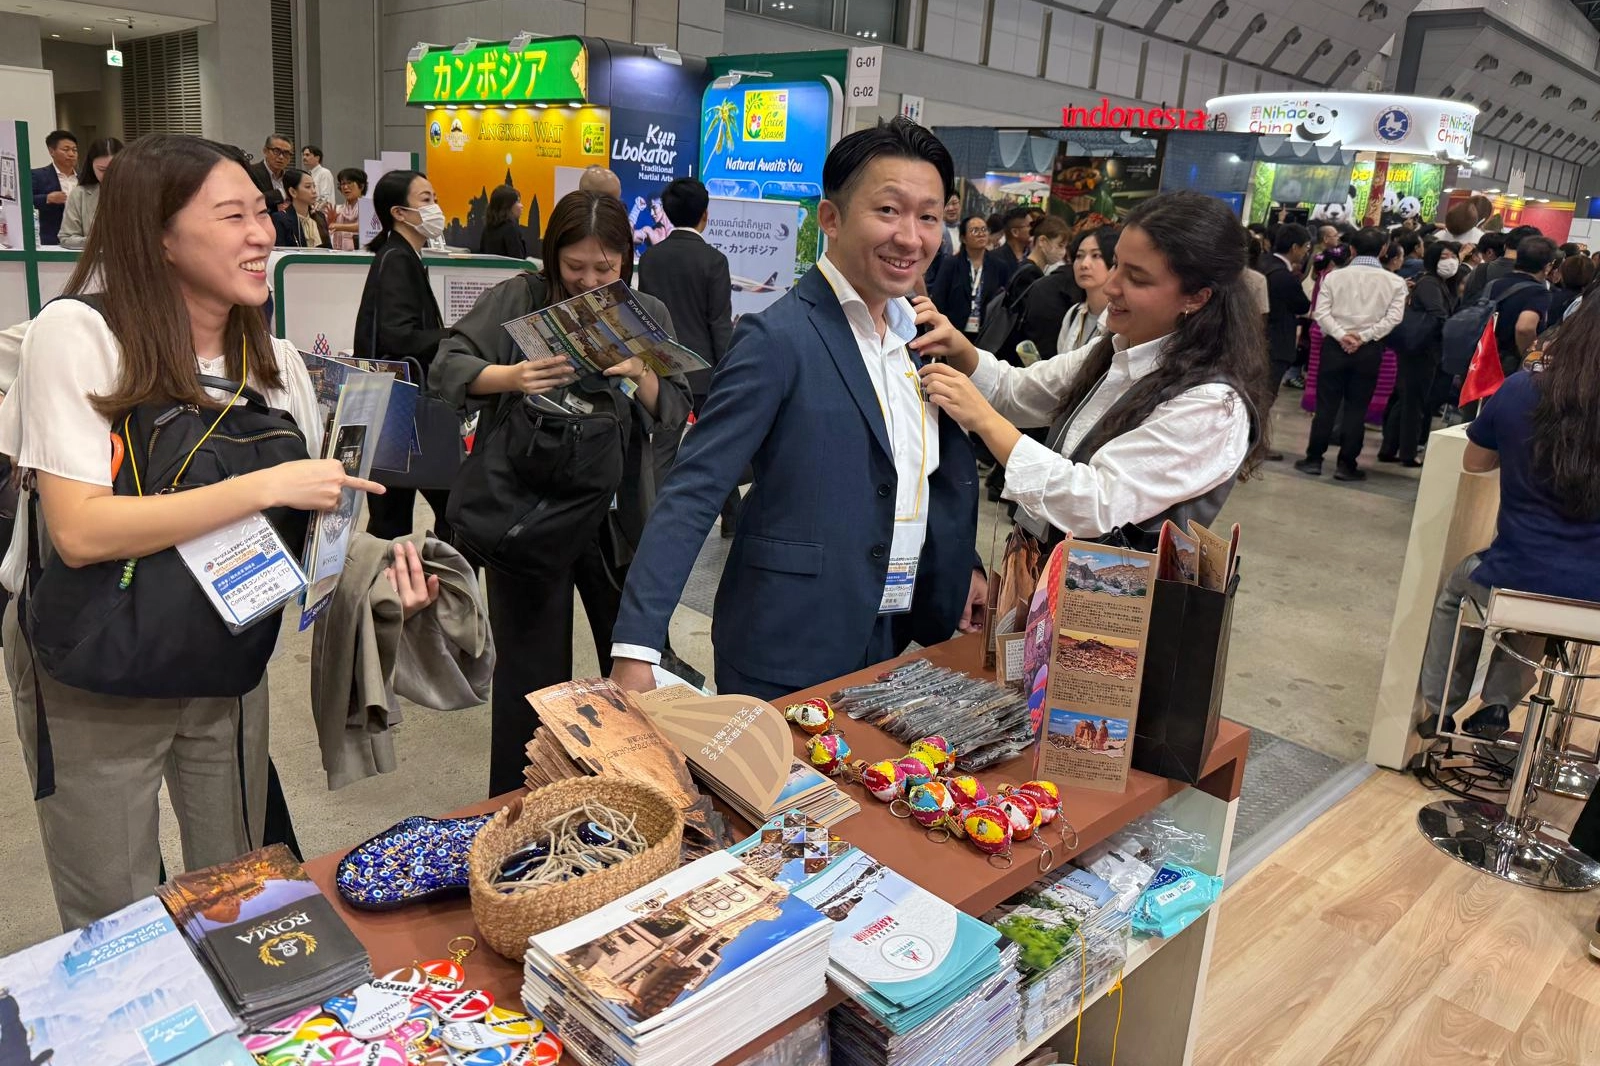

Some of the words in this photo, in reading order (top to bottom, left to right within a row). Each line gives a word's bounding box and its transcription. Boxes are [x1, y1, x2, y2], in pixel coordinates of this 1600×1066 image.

[856, 57, 876, 68] G-01
[434, 49, 547, 100] カンボジア
[853, 86, 874, 97] G-02
[764, 111, 784, 127] Green
[1062, 98, 1208, 131] indonesia
[1263, 105, 1308, 118] Nihao
[478, 122, 532, 142] ANGKOR
[534, 120, 563, 144] WAT
[762, 128, 784, 140] Season
[1249, 120, 1292, 134] China
[646, 124, 676, 148] Kun
[1438, 128, 1464, 144] China
[612, 138, 677, 164] Lbokator
[641, 164, 674, 174] Traditional
[726, 157, 756, 170] Natural
[757, 158, 786, 172] Awaits
[788, 158, 803, 172] You
[638, 172, 660, 182] Martial
[724, 229, 770, 239] CAMBODIA
[713, 243, 778, 256] ア・カンボジア
[626, 298, 643, 316] STAR
[640, 314, 657, 332] WARS
[216, 552, 235, 567] Tourism
[234, 546, 247, 557] Expo
[229, 588, 254, 606] Compact
[698, 705, 750, 756] 文化に触れる
[706, 704, 765, 763] 歴史を探求する
[234, 911, 312, 944] ROMA
[89, 919, 163, 957] ランドへようこそ
[372, 980, 419, 993] GÖREME
[346, 997, 407, 1031] Cappadocia
[368, 1010, 405, 1033] Capital
[376, 1011, 390, 1021] Of
